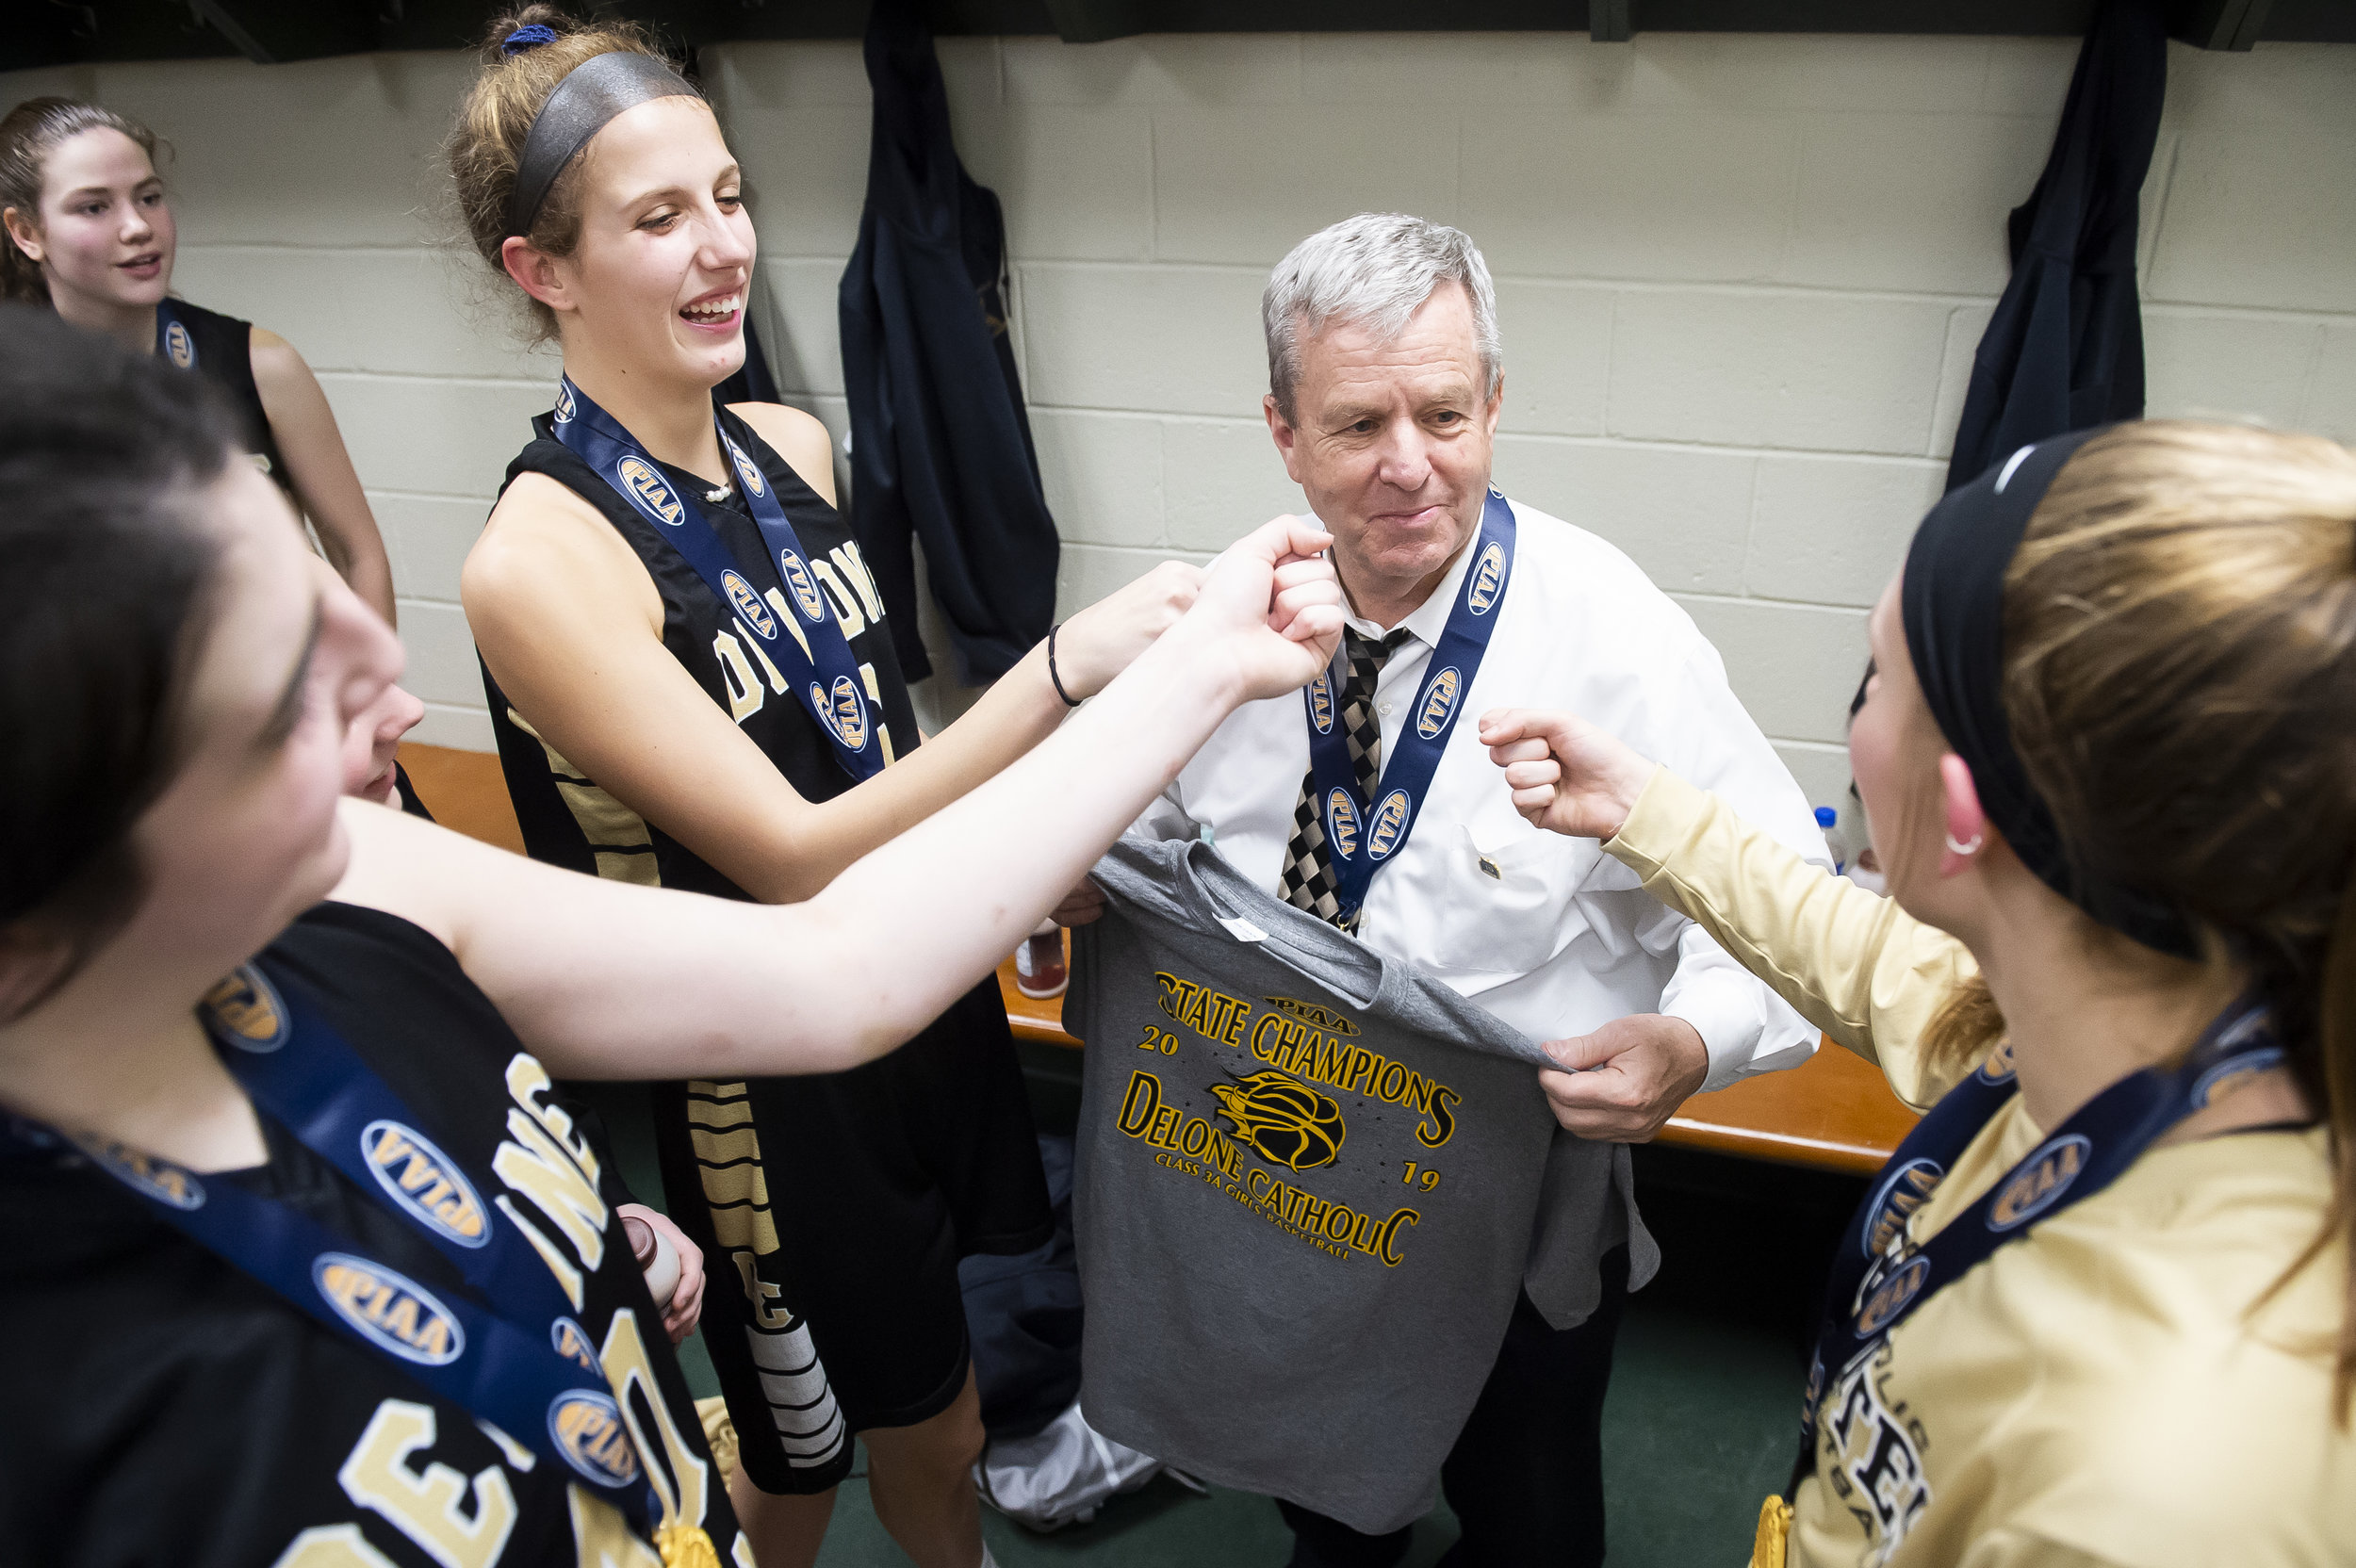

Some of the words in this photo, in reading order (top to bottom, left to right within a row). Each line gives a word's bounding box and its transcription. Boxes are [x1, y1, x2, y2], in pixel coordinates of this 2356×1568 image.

[620, 460, 682, 524] PIAA
[724, 573, 775, 639] PIAA
[784, 554, 822, 618] PIAA
[1471, 545, 1502, 609] PIAA
[837, 680, 865, 748] PIAA
[1419, 670, 1457, 733] PIAA
[1332, 792, 1357, 855] PIAA
[1369, 792, 1406, 855] PIAA
[1137, 1024, 1180, 1057] 20
[1272, 998, 1355, 1034] PIAA
[1154, 971, 1252, 1047] STATE
[1251, 1012, 1462, 1149] CHAMPIONS
[370, 1127, 486, 1238] PIAA
[1116, 1070, 1246, 1181] DELONE
[1246, 1168, 1420, 1267] CATHOLIC
[1400, 1160, 1441, 1193] 19
[1154, 1152, 1201, 1177] CLASS
[1202, 1170, 1223, 1190] 3A
[1225, 1184, 1262, 1216] GIRLS
[1266, 1212, 1351, 1261] BASKETBALL
[323, 1264, 450, 1357] PIAA
